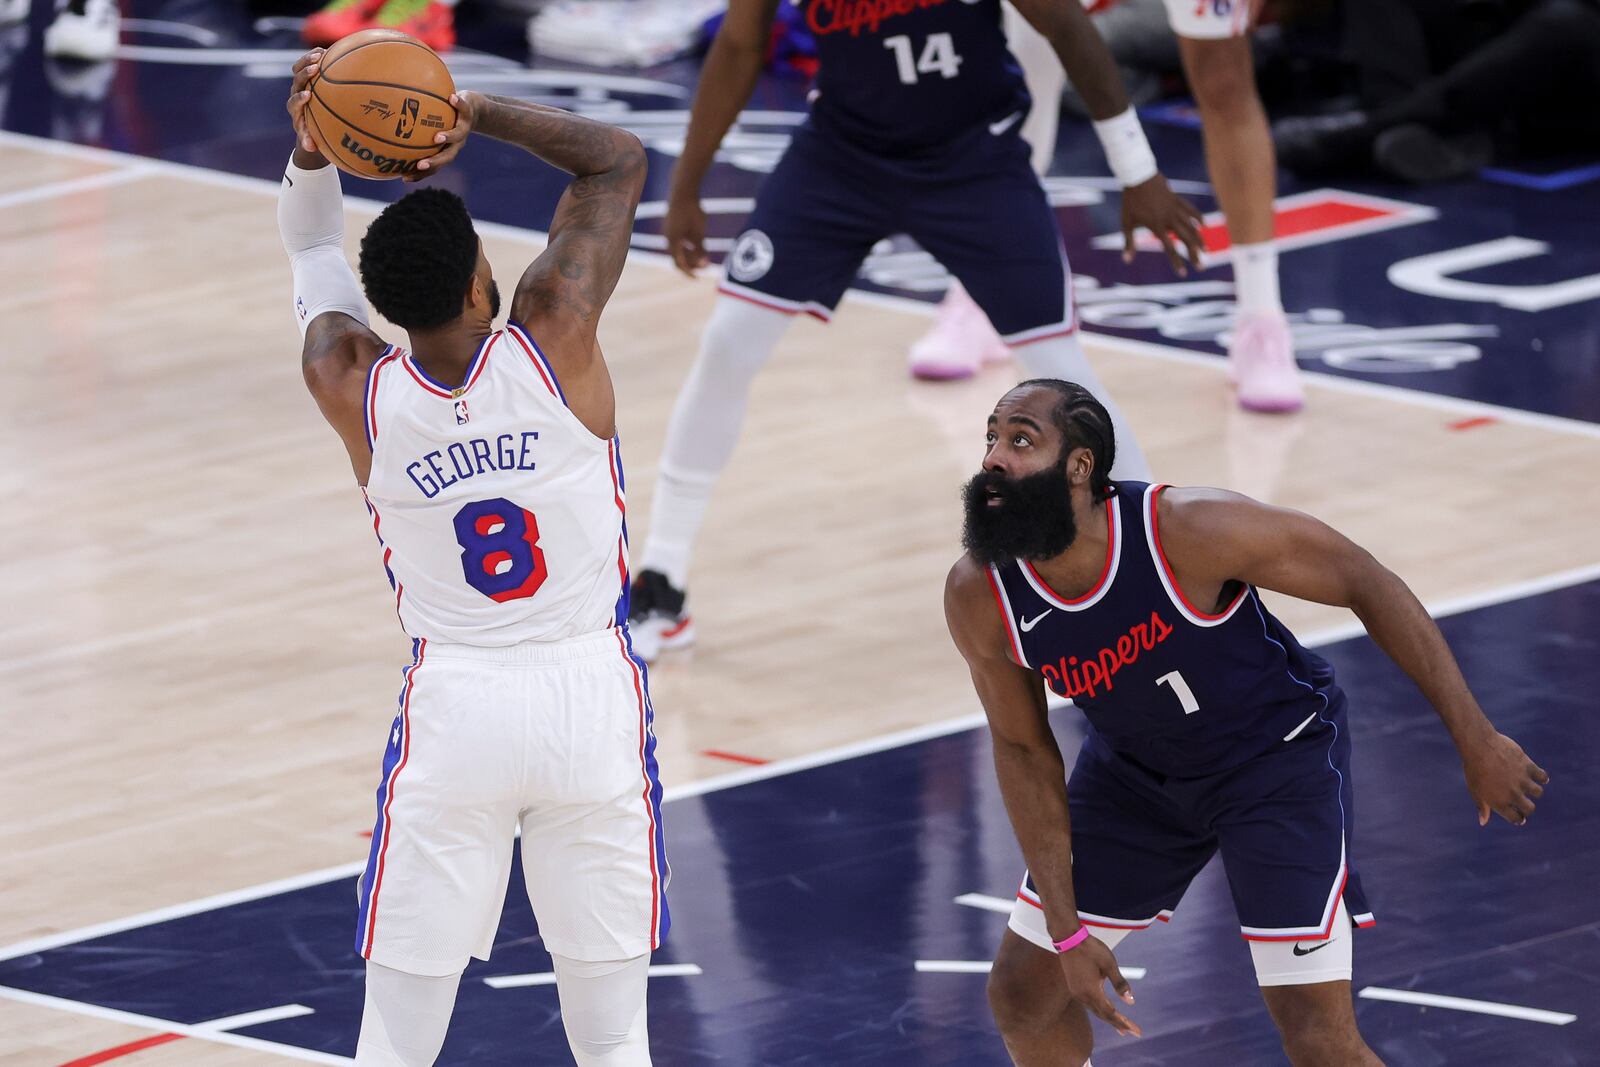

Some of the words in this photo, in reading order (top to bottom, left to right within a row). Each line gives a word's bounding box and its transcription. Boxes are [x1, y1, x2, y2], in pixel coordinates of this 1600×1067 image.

[806, 0, 946, 37] Clippe
[883, 32, 963, 84] 14
[406, 431, 539, 499] GEORGE
[453, 497, 549, 604] 8
[1041, 611, 1173, 699] Clippers
[1155, 670, 1200, 715] 1
